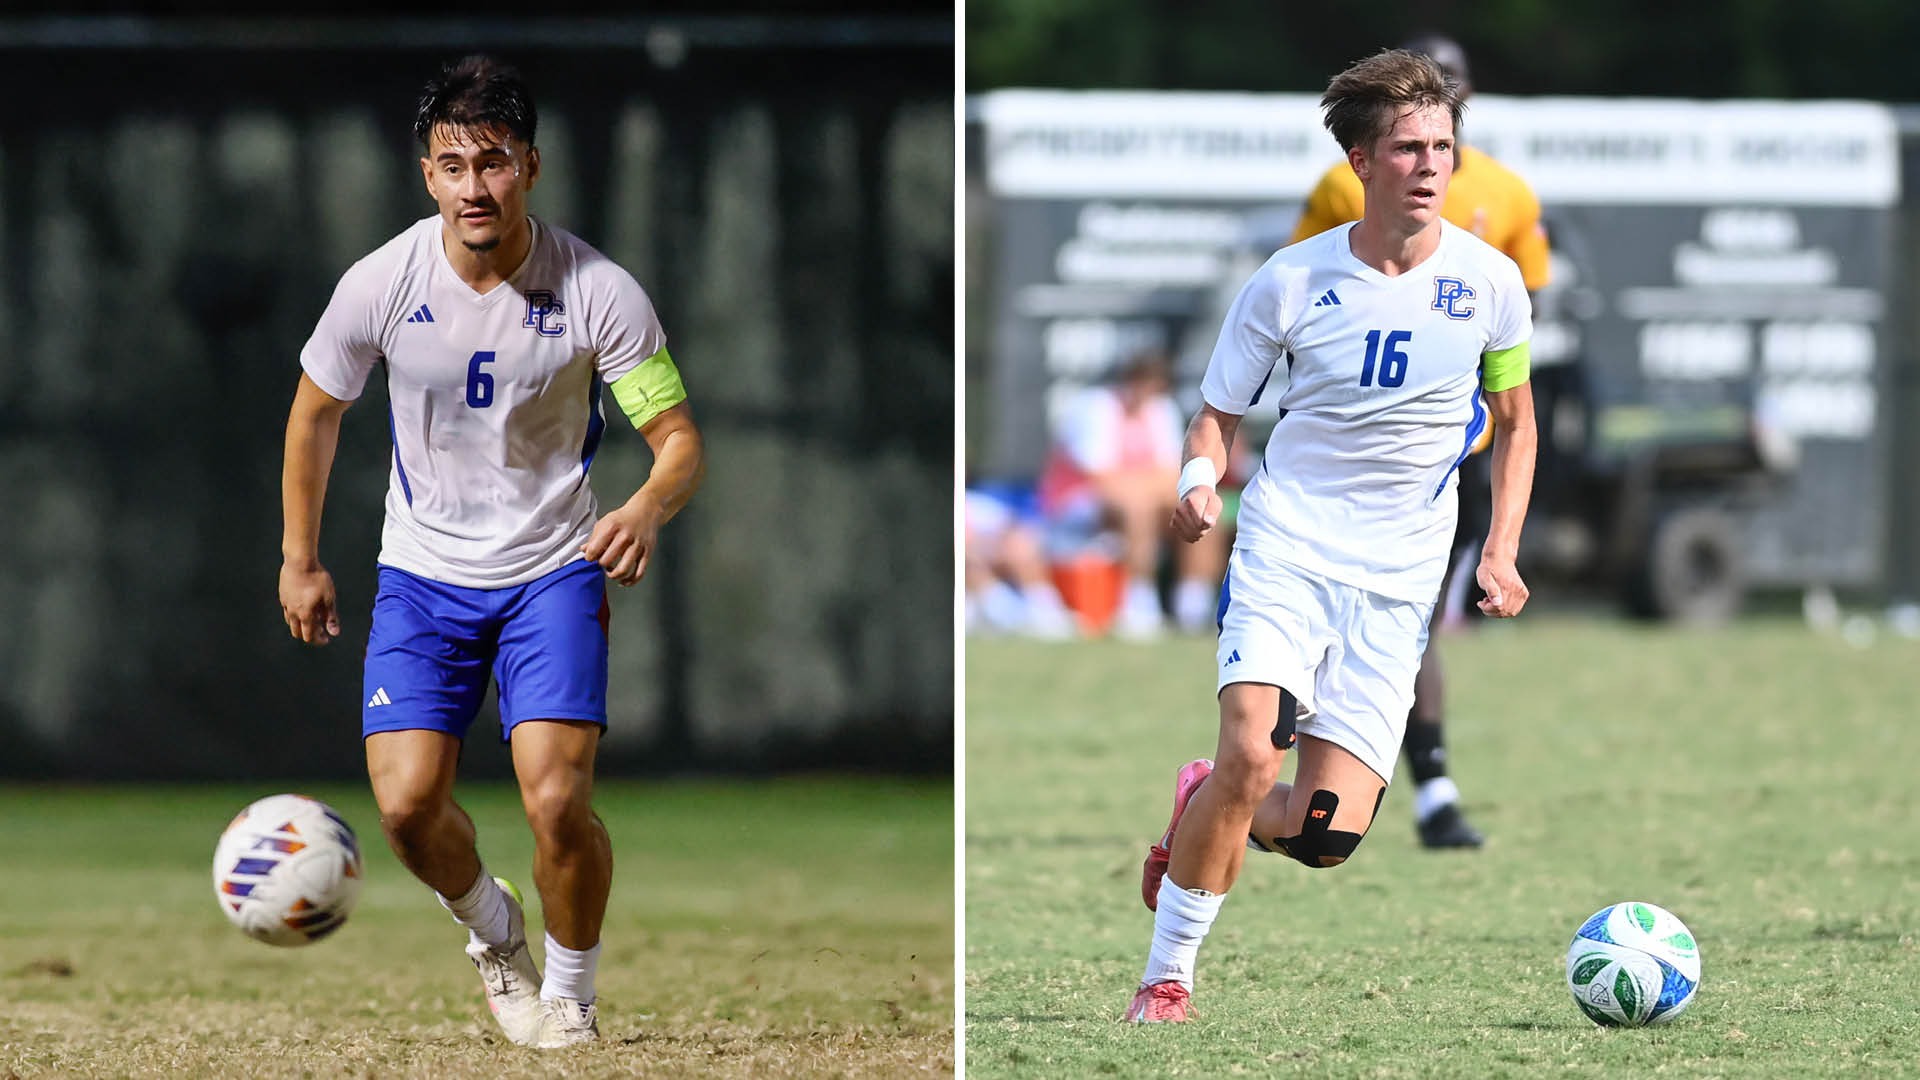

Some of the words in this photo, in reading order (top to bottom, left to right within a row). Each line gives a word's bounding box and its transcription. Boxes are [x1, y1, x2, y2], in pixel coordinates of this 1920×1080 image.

[523, 290, 566, 337] PC
[1431, 276, 1476, 321] PC
[466, 351, 496, 409] 6
[1359, 329, 1412, 388] 16
